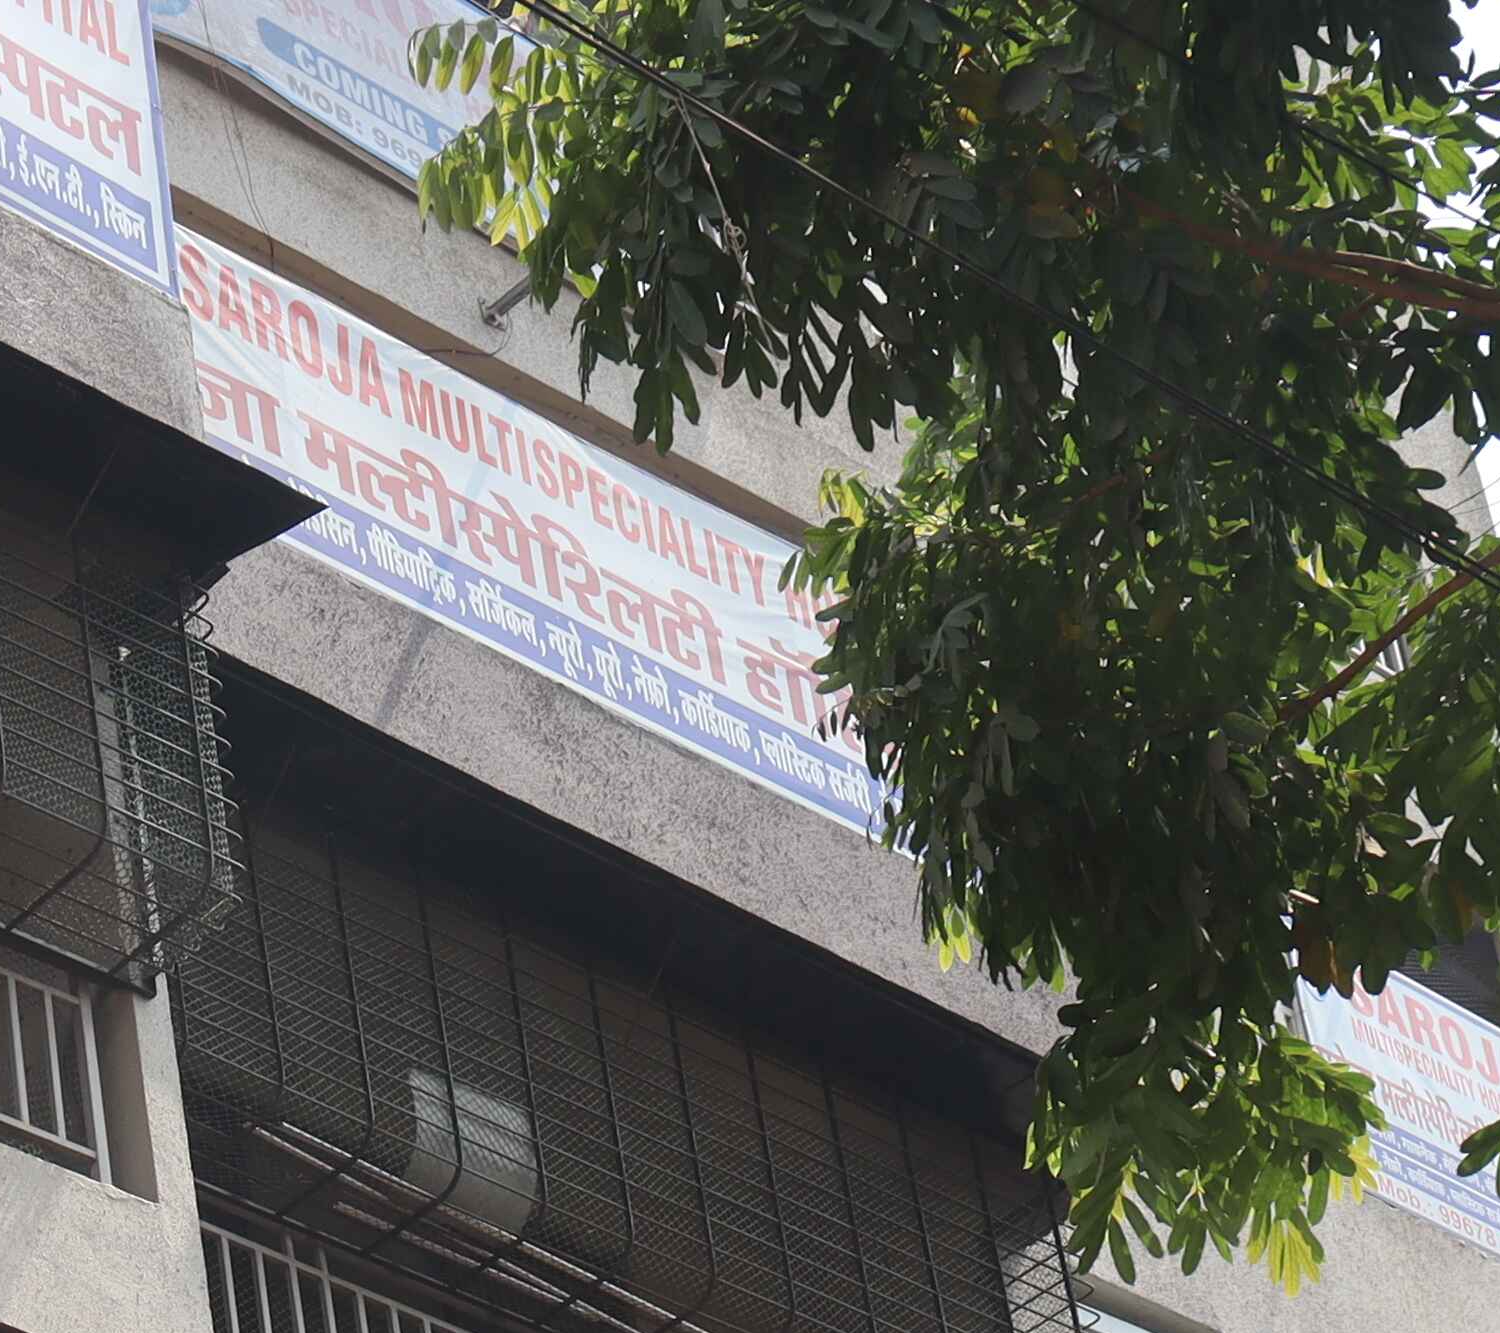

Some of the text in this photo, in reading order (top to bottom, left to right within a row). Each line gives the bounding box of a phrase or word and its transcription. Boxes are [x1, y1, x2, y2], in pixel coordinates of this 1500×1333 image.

[286, 74, 365, 139] MOB:
[292, 41, 429, 146] COMING
[179, 243, 393, 420] SAROJA
[398, 367, 767, 608] MULTISPECIALITY
[1352, 1017, 1473, 1104] MULTISPECIALITY
[1438, 1205, 1498, 1247] 99678
